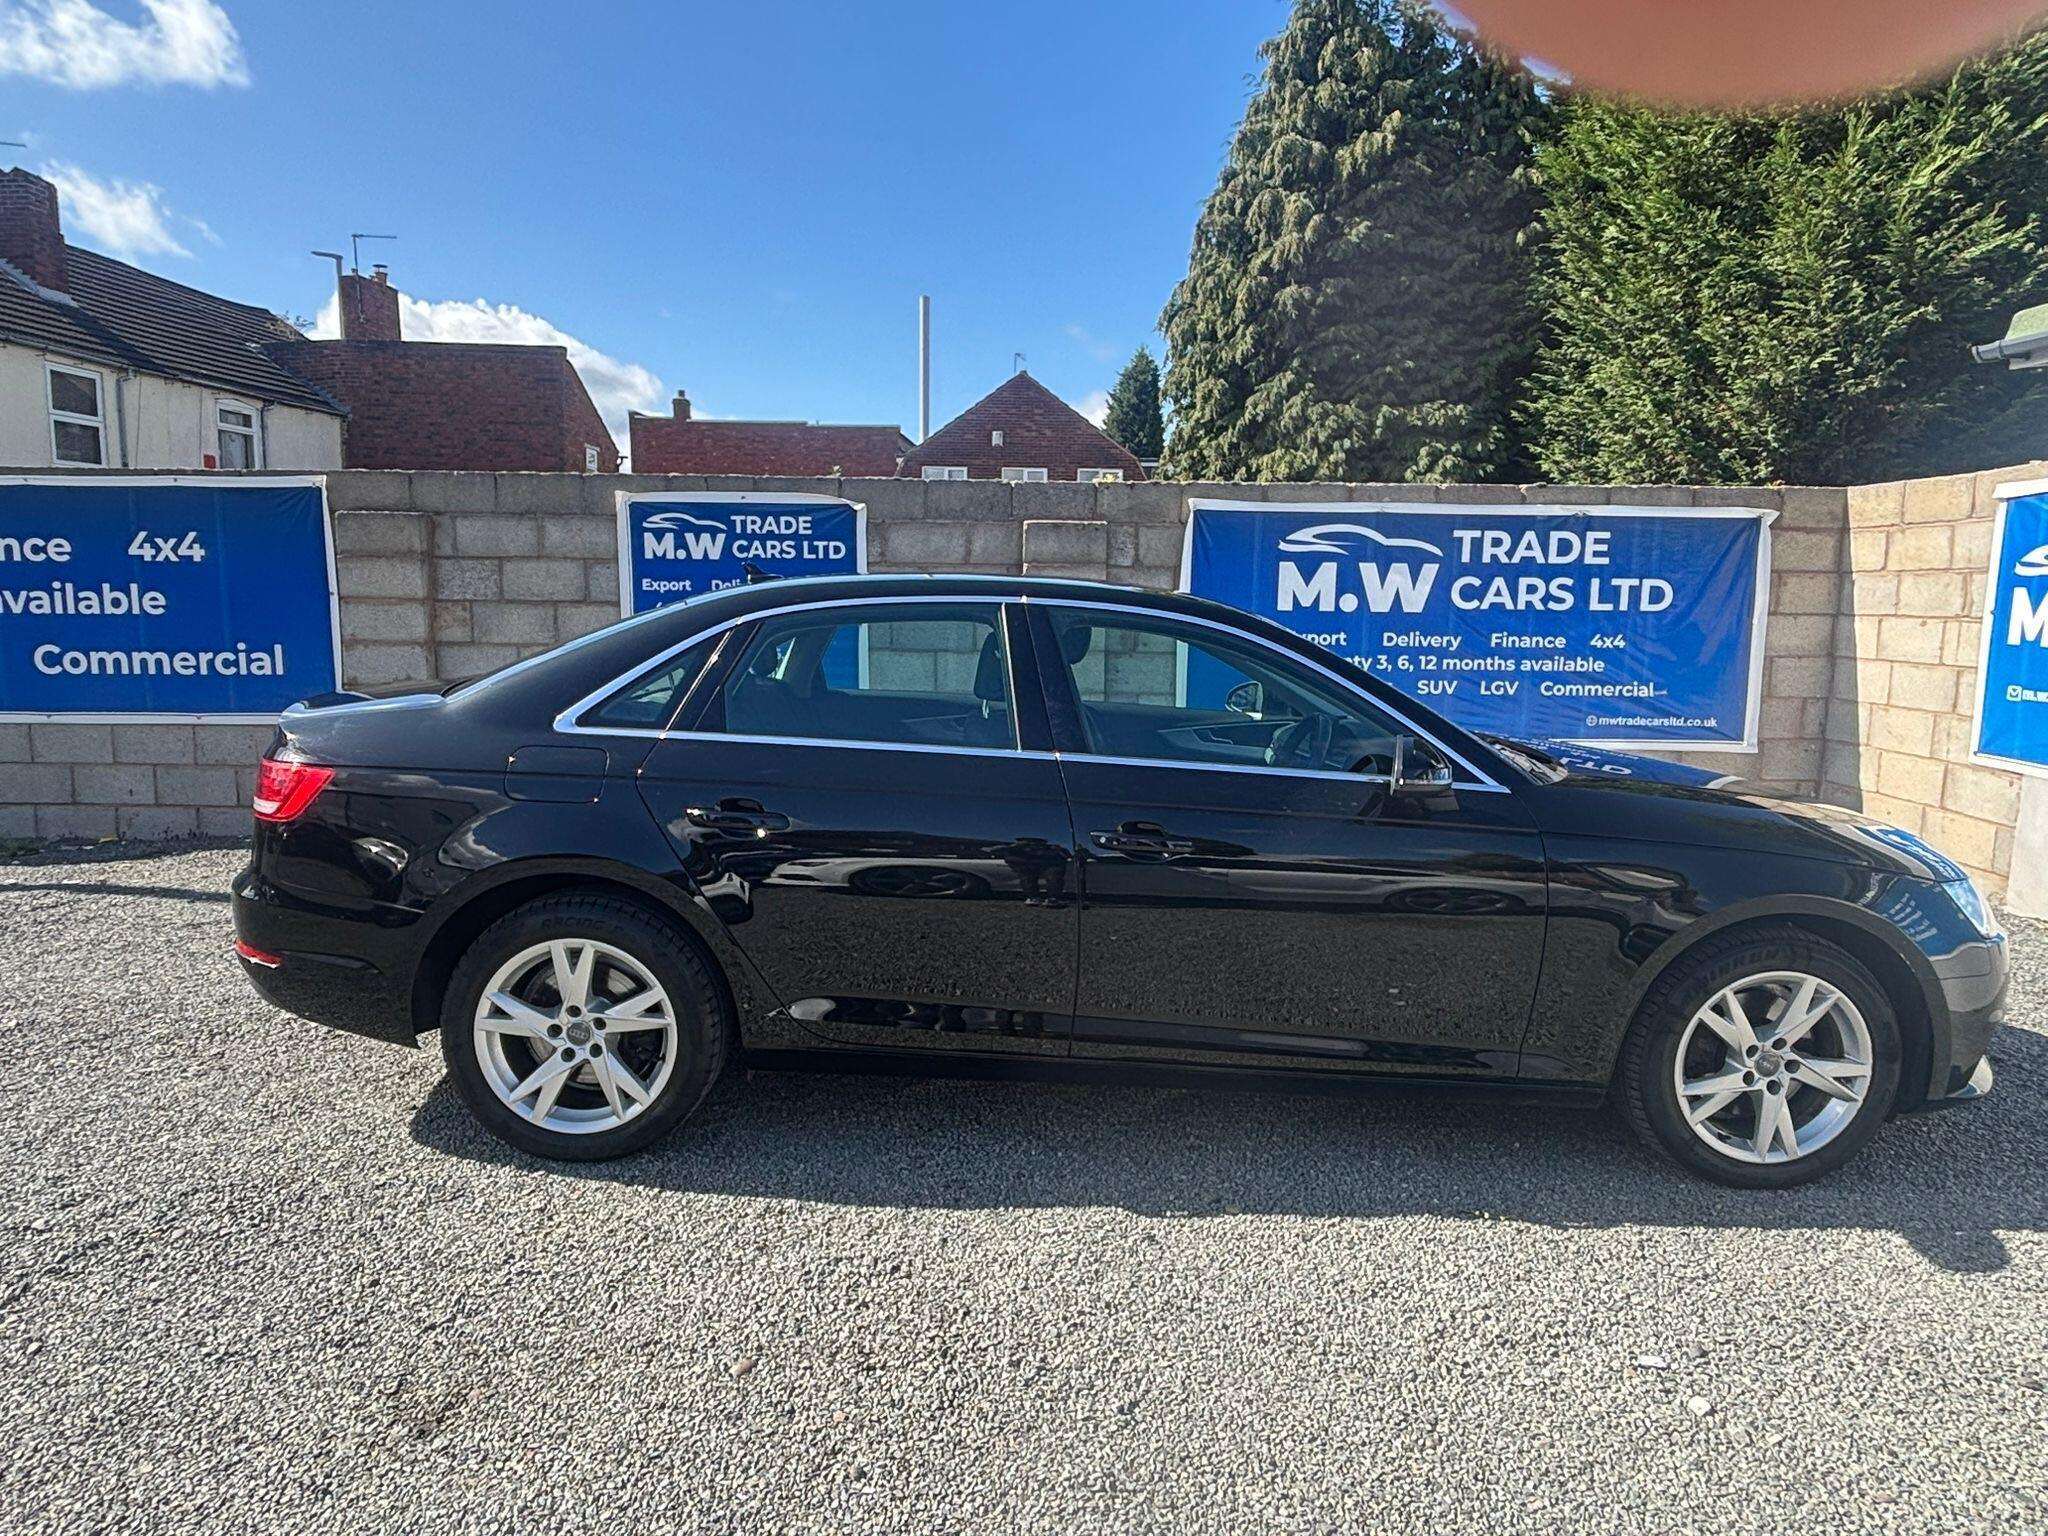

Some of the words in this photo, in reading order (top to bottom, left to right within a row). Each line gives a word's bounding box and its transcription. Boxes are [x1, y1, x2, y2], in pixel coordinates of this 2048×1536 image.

[730, 515, 812, 535] TRADE
[127, 531, 206, 562] 4x4
[643, 532, 727, 560] M.W
[732, 540, 797, 559] CARS
[803, 540, 846, 559] LTD
[1453, 529, 1612, 565] TRADE
[641, 578, 692, 593] Export
[1276, 561, 1440, 614] M.W
[1450, 575, 1575, 611] CARS
[1589, 577, 1674, 612] LTD
[1296, 631, 1347, 647] port
[1382, 630, 1462, 651] Delivery
[1490, 631, 1567, 649] Finance
[1590, 633, 1626, 649] 4x4
[33, 643, 284, 676] Commercial
[1376, 655, 1392, 673] 3,
[1397, 655, 1415, 673] 6,
[1418, 655, 1438, 670] 12
[1442, 656, 1517, 672] months
[1520, 656, 1605, 673] available
[1417, 679, 1458, 695] SUV
[1480, 680, 1519, 696] LGV
[1540, 681, 1655, 698] Commercial
[1598, 715, 1718, 728] mwtradecarsltd.co.uk
